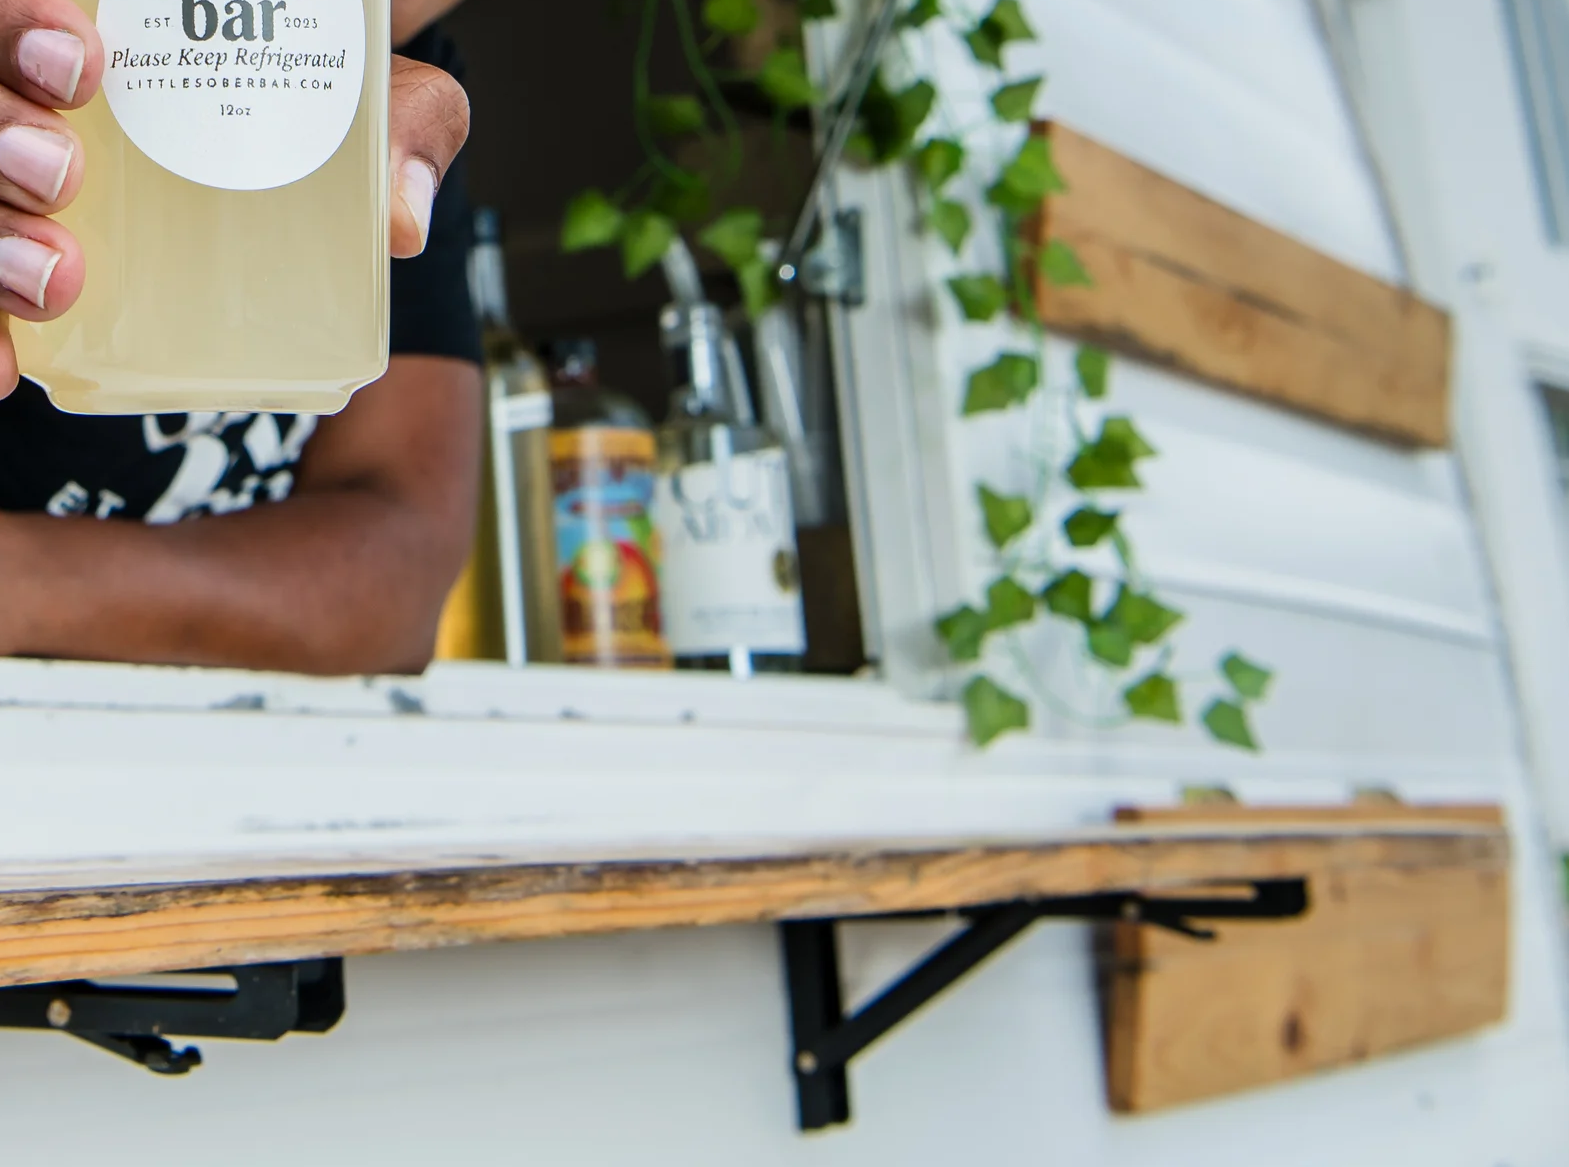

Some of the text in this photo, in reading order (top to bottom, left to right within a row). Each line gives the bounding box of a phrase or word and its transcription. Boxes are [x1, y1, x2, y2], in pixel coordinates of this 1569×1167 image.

[284, 16, 319, 30] 2023
[109, 45, 346, 73] Please Keep Refrigerated
[126, 77, 334, 91] LITTLESOBERBAR.COM
[220, 103, 253, 117] 12oz
